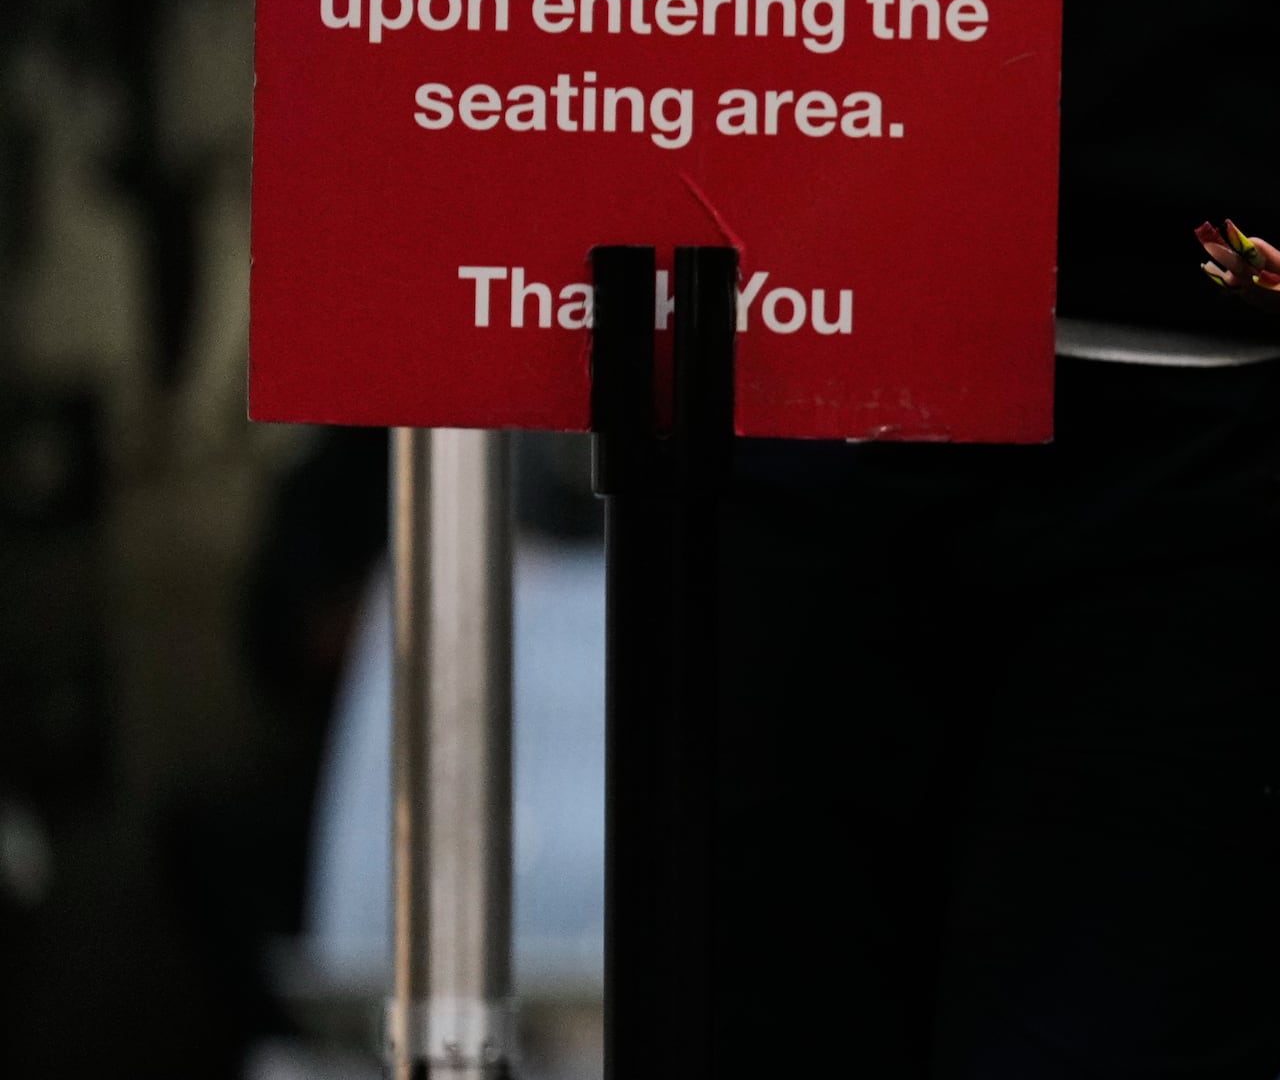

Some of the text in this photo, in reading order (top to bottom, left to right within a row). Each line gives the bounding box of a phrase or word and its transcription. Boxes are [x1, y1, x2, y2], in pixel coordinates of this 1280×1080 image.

[413, 70, 904, 150] seating area.
[457, 265, 853, 335] Thak You
